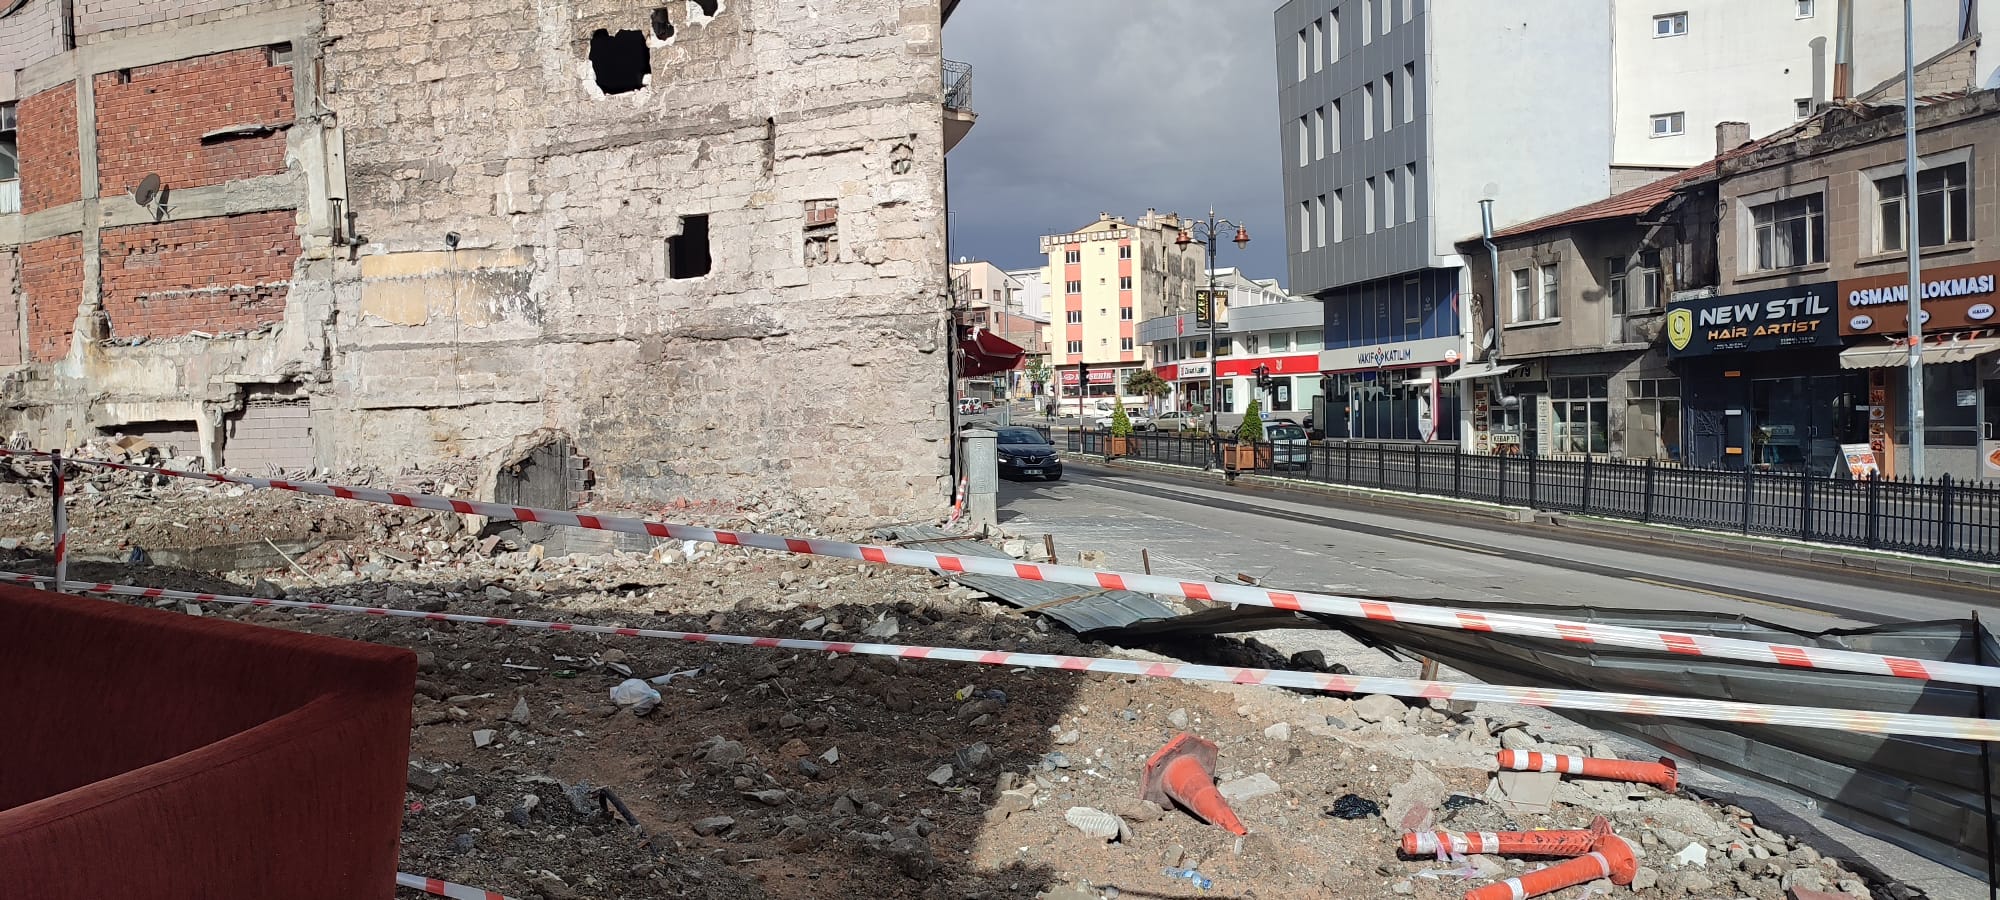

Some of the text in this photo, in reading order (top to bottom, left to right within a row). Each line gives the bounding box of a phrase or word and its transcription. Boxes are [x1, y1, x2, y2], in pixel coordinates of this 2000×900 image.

[1921, 274, 1994, 299] LOKMASI
[1699, 291, 1830, 327] NEW STİL
[1357, 348, 1411, 365] VAKIF KATILIM
